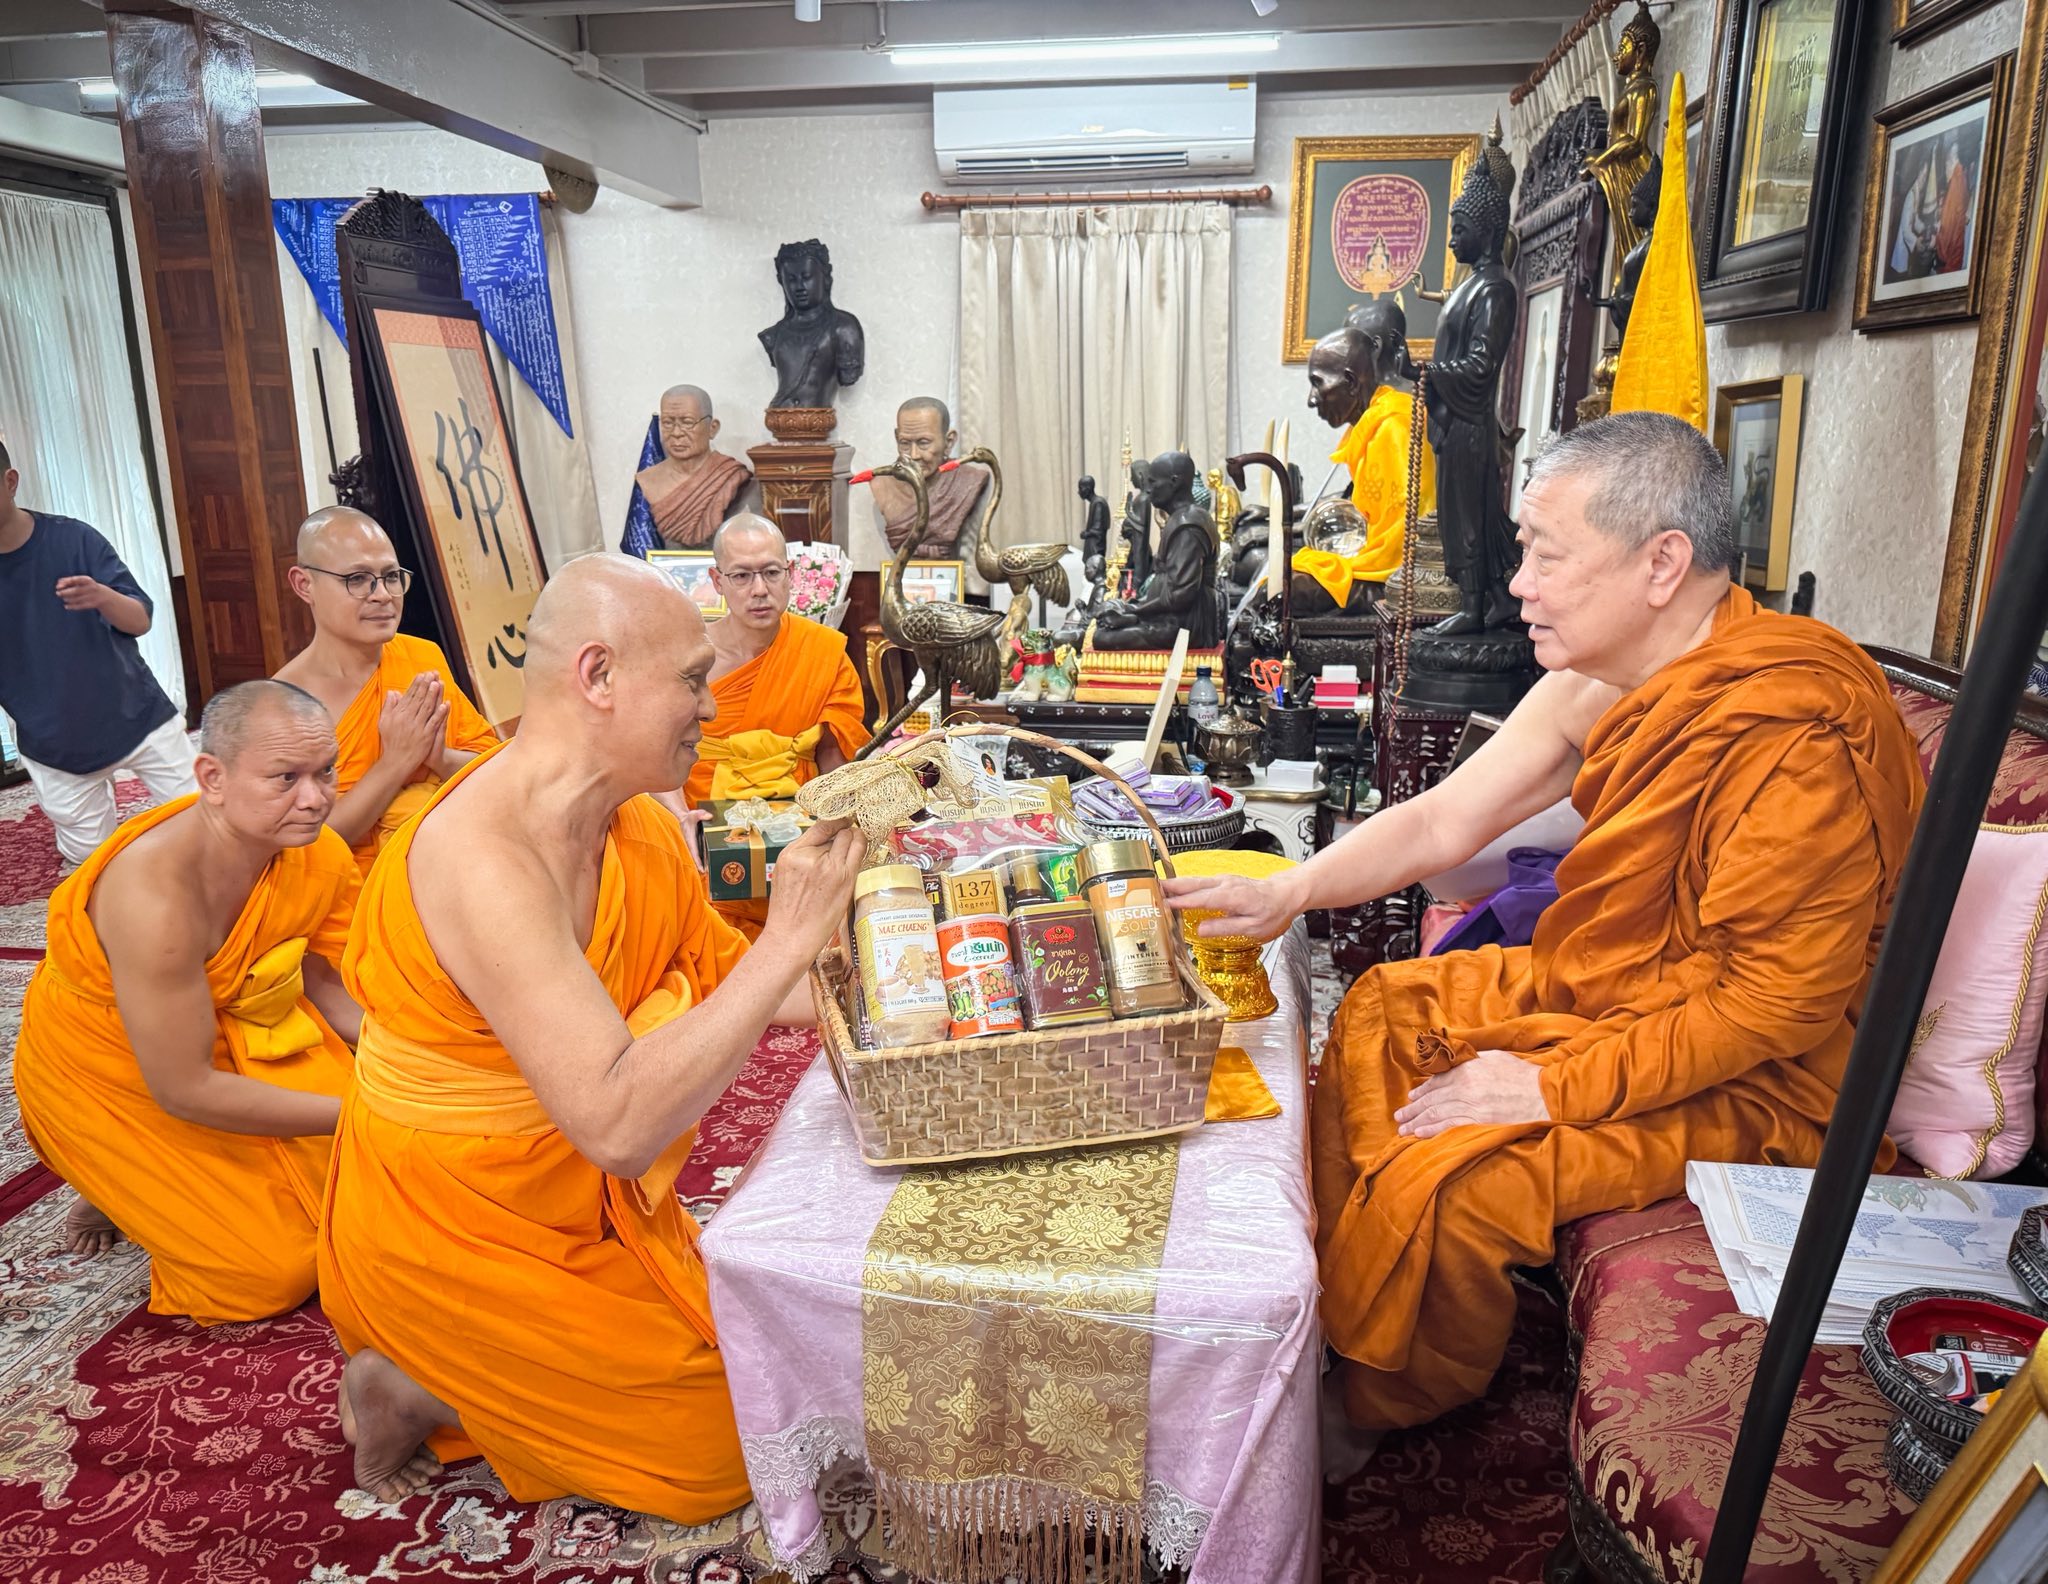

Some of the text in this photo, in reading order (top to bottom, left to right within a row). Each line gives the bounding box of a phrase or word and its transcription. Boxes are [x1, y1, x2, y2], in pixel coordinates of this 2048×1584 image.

[956, 880, 991, 898] 137
[958, 900, 995, 910] degrees
[878, 925, 896, 935] MAE
[1119, 919, 1158, 933] GOLD
[1127, 951, 1160, 960] INTENSE
[1045, 959, 1090, 987] Oolong
